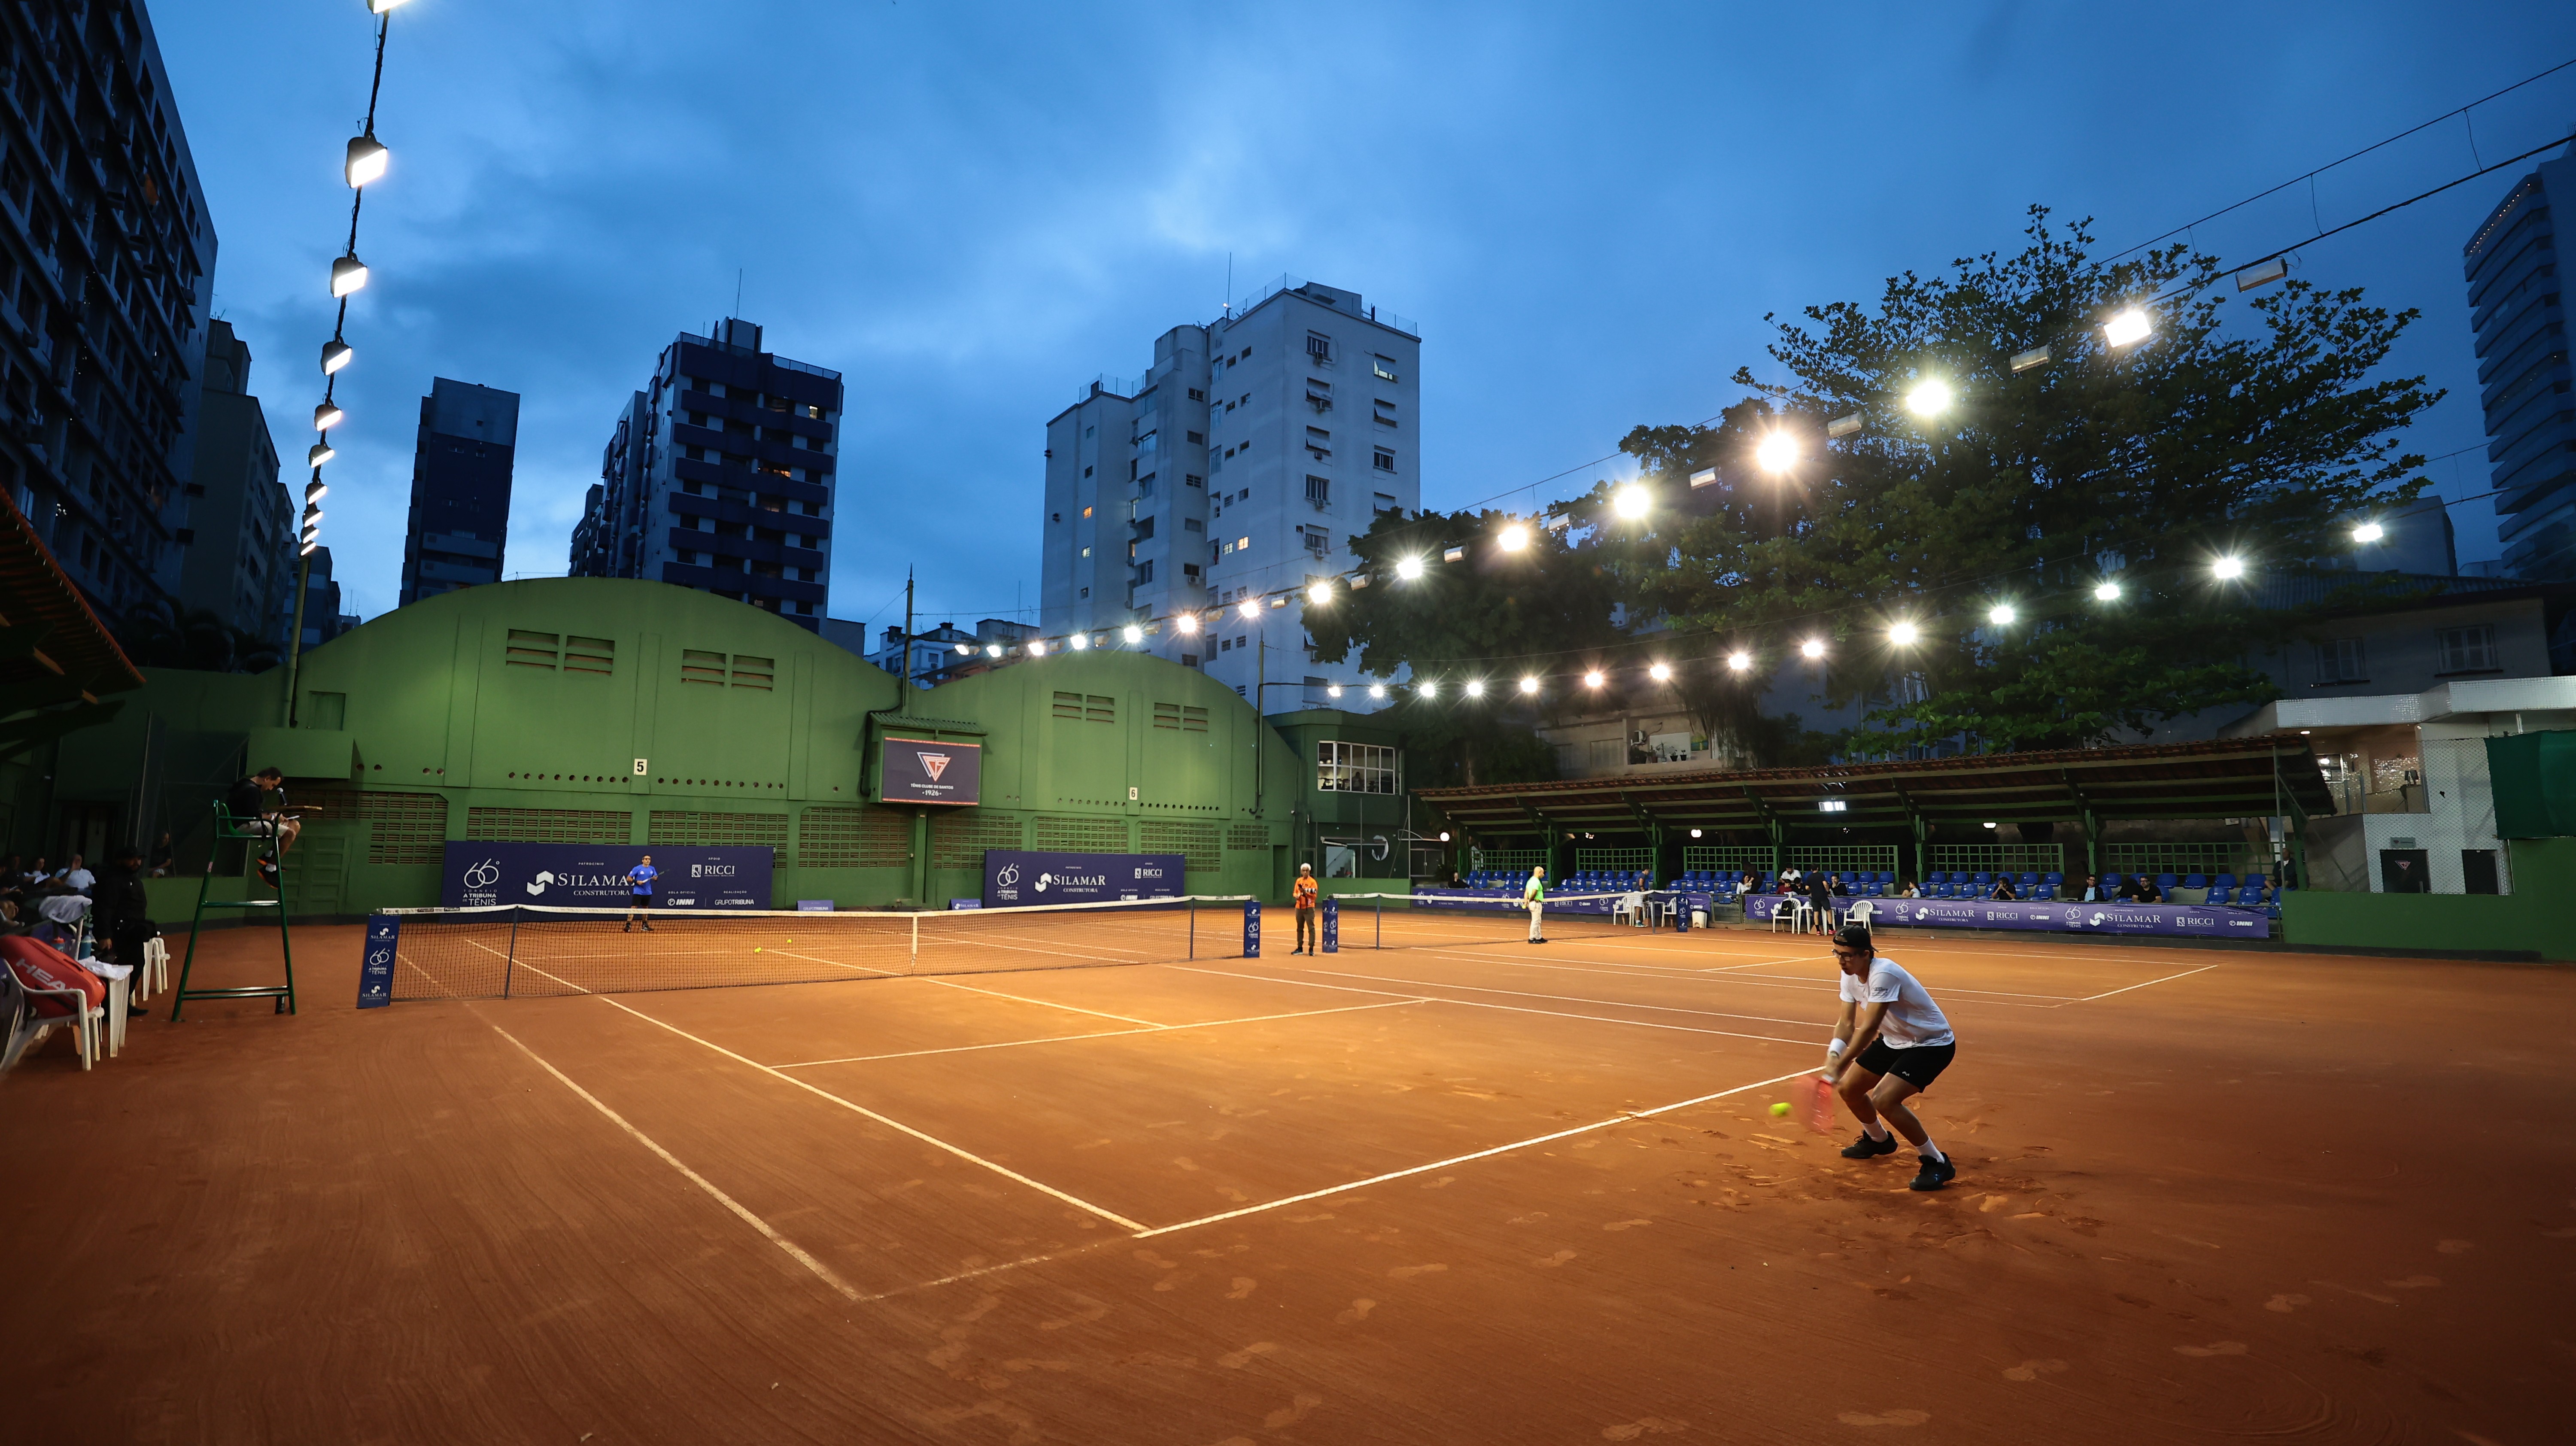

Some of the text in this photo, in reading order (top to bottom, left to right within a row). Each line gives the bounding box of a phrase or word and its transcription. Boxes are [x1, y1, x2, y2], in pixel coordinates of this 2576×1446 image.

[637, 762, 644, 772] 5
[704, 865, 735, 874] RICCI
[558, 873, 635, 886] SILAMA
[1053, 874, 1106, 885] SILAMAR
[468, 898, 496, 906] TÊNIS
[1930, 908, 1975, 917] SILAMAR
[2107, 913, 2162, 923] SILAMAR
